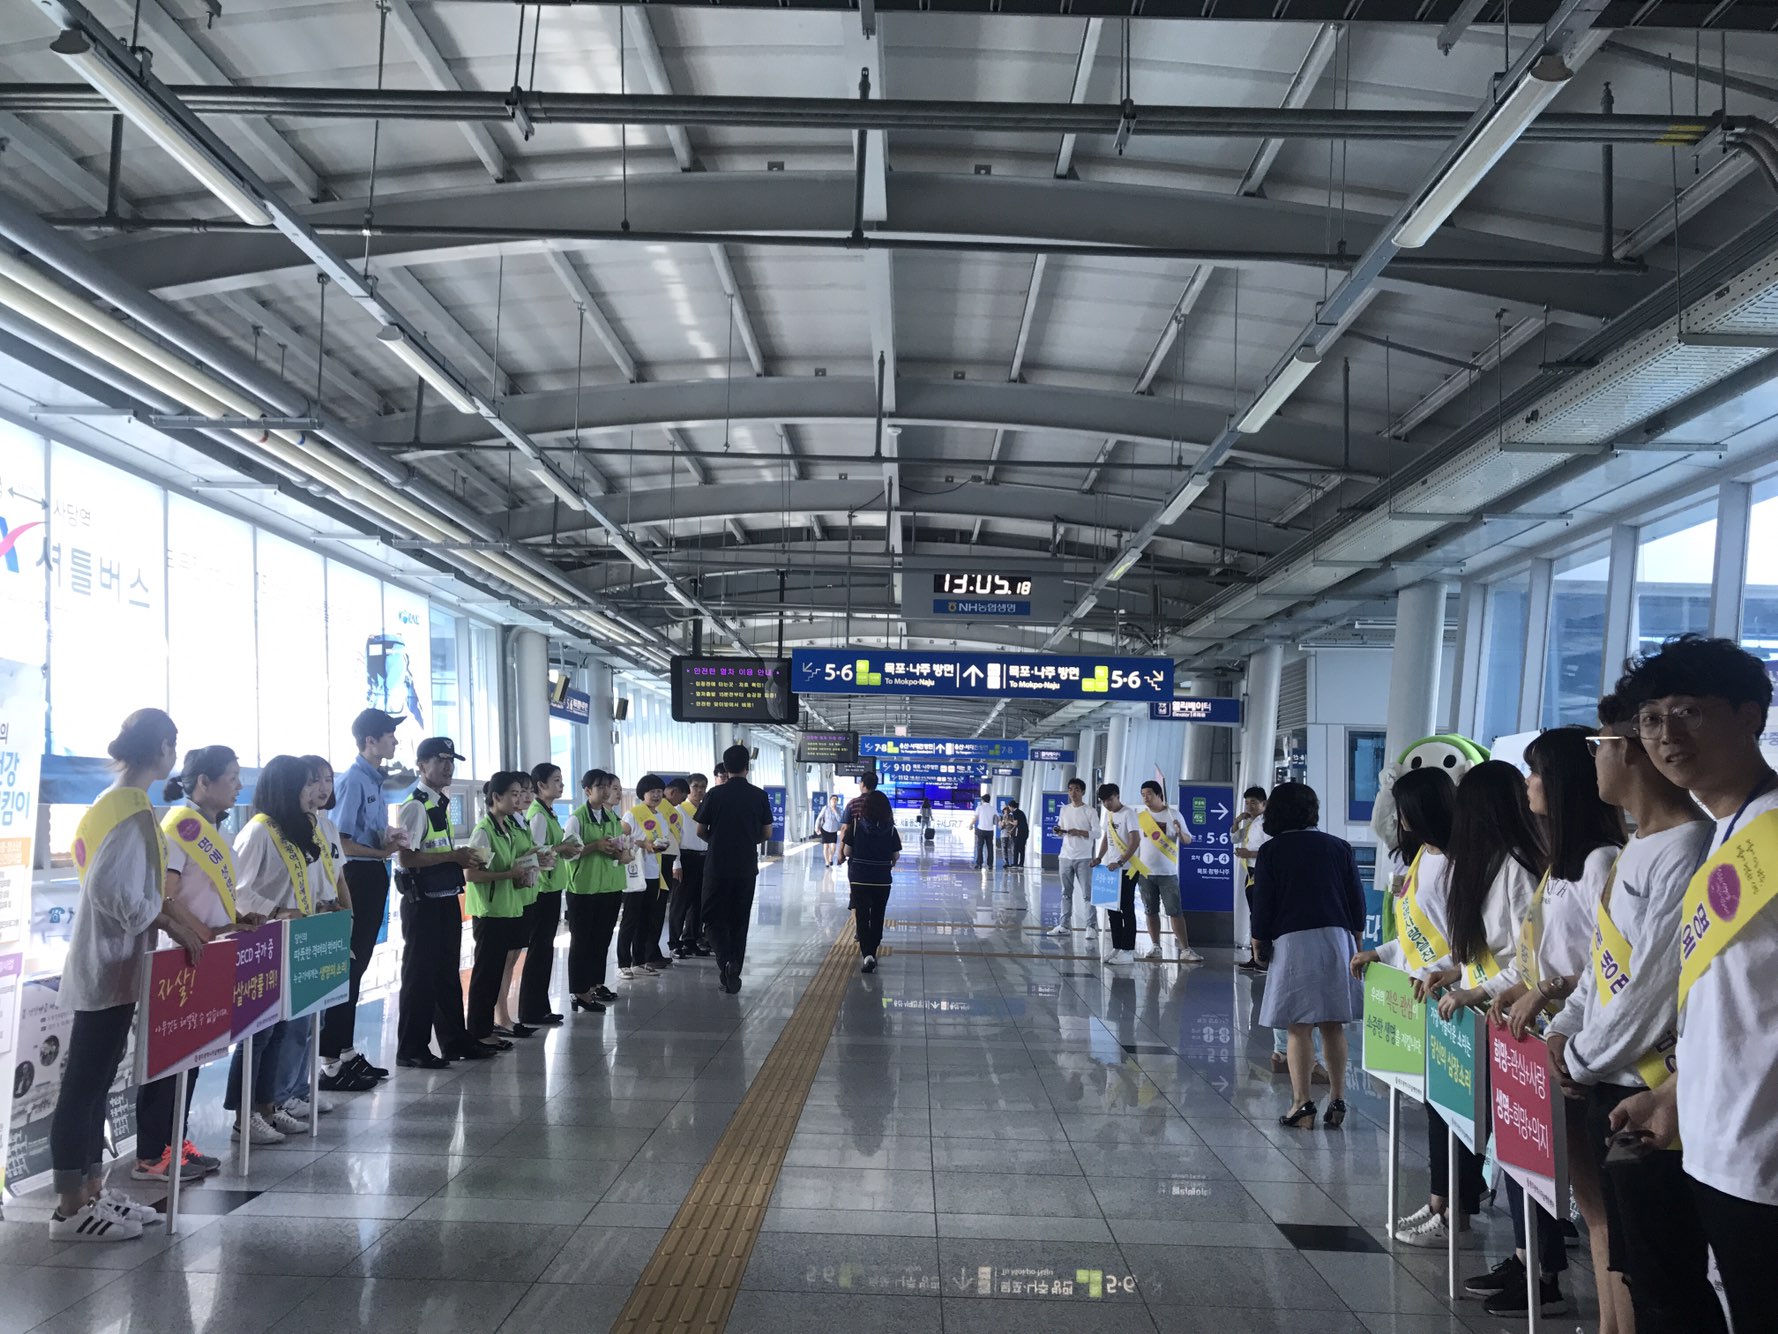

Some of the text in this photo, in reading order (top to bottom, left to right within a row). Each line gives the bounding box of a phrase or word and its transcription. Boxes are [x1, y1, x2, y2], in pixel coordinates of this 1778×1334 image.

[53, 498, 91, 528] 사당역
[36, 536, 151, 609] 셔틀버스
[958, 602, 1016, 613] NH농협생명
[693, 667, 772, 677] 안전한 열차 이용 안내
[884, 662, 931, 677] 목포·나주
[932, 663, 955, 677] 방면
[1008, 664, 1057, 678] 목포·나주
[1058, 666, 1080, 681] 방면
[1009, 680, 1017, 688] To
[1172, 700, 1212, 712] 엘리베이터
[254, 941, 267, 964] 국가
[267, 937, 274, 960] 중
[293, 944, 311, 961] 따뜻한
[1370, 986, 1385, 1006] 우리의
[1385, 989, 1399, 1014] 작은
[154, 1017, 178, 1037] 아무것도
[180, 1011, 198, 1030] 해결할
[198, 1012, 204, 1026] 수
[1366, 1014, 1384, 1039] 소중한
[1384, 1018, 1400, 1047] 생명을
[1430, 1034, 1447, 1068] 당신의
[1457, 1029, 1472, 1059] 소리는
